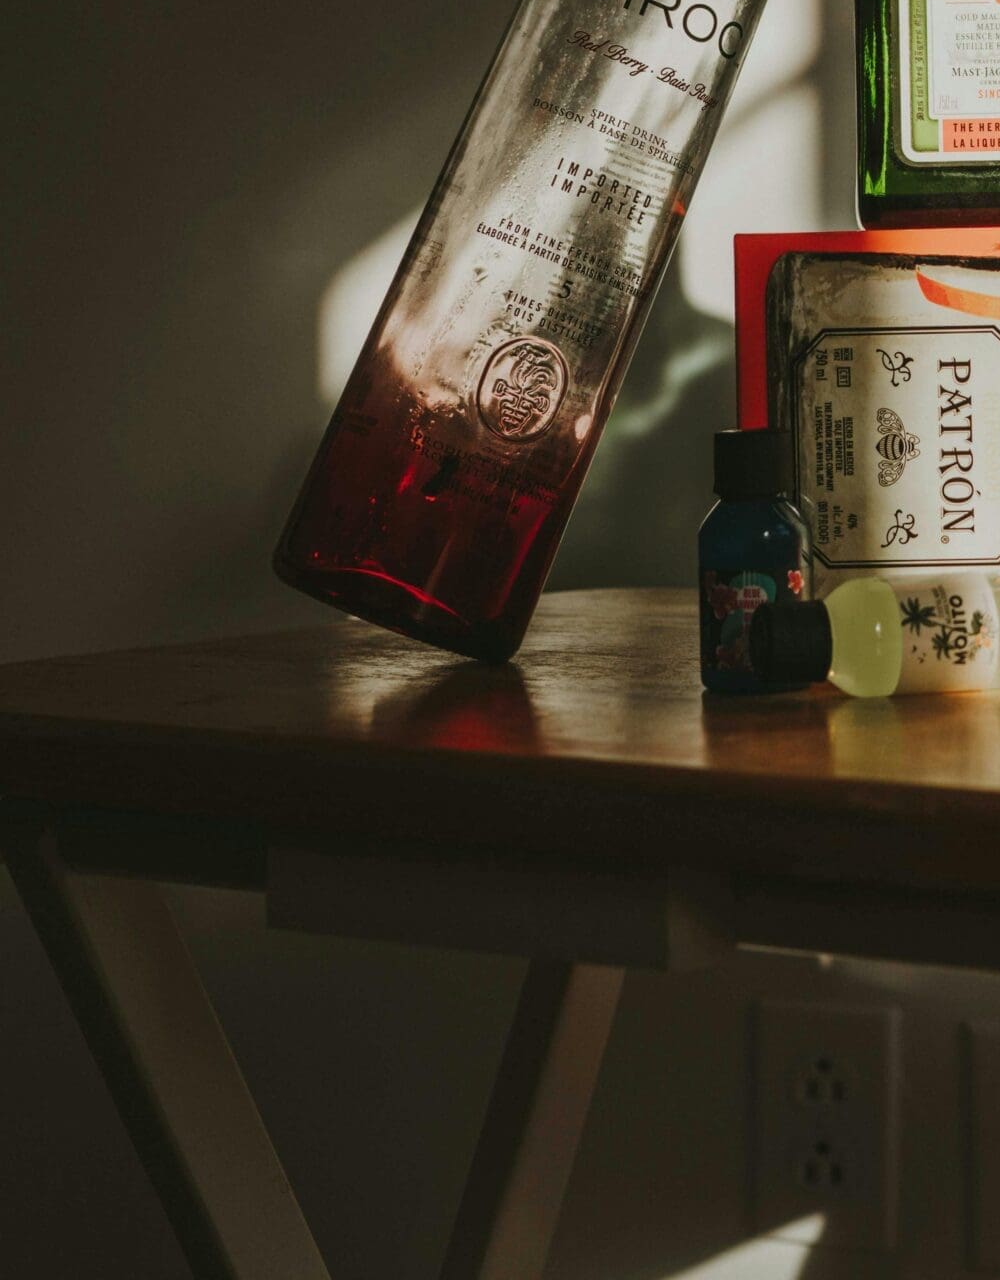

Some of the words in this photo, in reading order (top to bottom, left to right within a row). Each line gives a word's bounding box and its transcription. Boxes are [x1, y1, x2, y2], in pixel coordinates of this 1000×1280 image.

[567, 29, 609, 54] Red
[603, 43, 649, 77] Berry
[656, 66, 690, 93] Baies
[955, 33, 993, 41] ESSENCE
[533, 98, 585, 124] BOISSON
[598, 124, 627, 144] BASE
[629, 137, 646, 152] DE
[590, 108, 630, 132] SPIRIT
[632, 125, 669, 150] DRINK
[953, 122, 974, 132] THE
[953, 138, 965, 148] LA
[550, 174, 647, 226] IMPORTÉE
[557, 157, 653, 209] IMPORTED
[476, 220, 518, 248] ÉLABORÉE
[528, 244, 561, 265] PARTIR
[561, 257, 575, 270] DE
[499, 218, 532, 238] FROM
[536, 232, 564, 252] FINE
[568, 246, 611, 270] FRENCH
[503, 289, 543, 313] TIMES
[547, 305, 604, 338] DISTILLED
[505, 304, 533, 323] FOIS
[558, 280, 574, 299] 5
[816, 348, 827, 366] 750
[937, 357, 981, 534] PATRÓN
[847, 513, 858, 530] 40%
[949, 595, 970, 665] MOJITO
